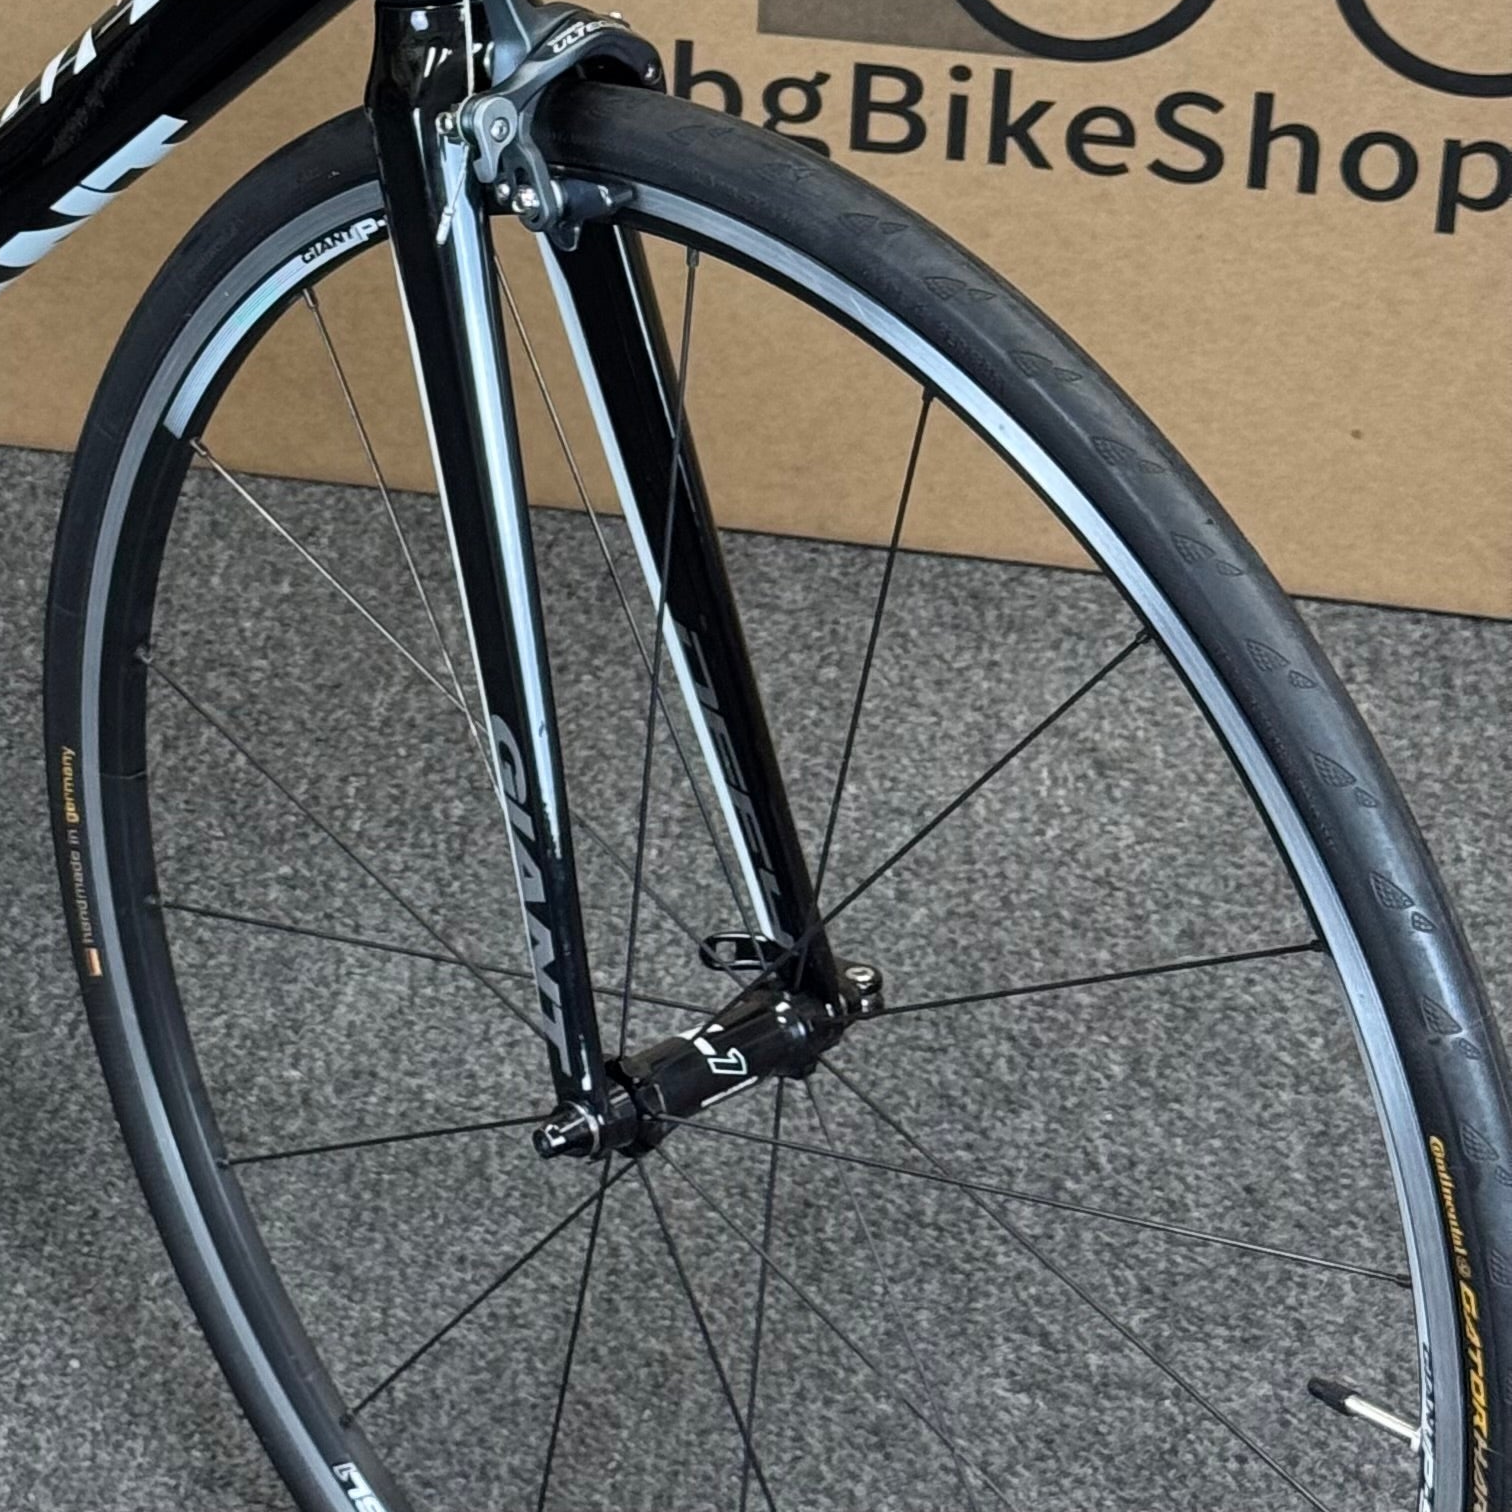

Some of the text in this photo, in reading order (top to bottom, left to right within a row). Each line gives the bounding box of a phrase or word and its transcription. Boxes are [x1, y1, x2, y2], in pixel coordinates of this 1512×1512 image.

[673, 40, 1512, 234] bgBikeShop
[301, 226, 354, 264] GIANT
[61, 745, 94, 944] handmade in germany
[491, 714, 573, 1078] GIANT
[1429, 1135, 1468, 1256] Continental
